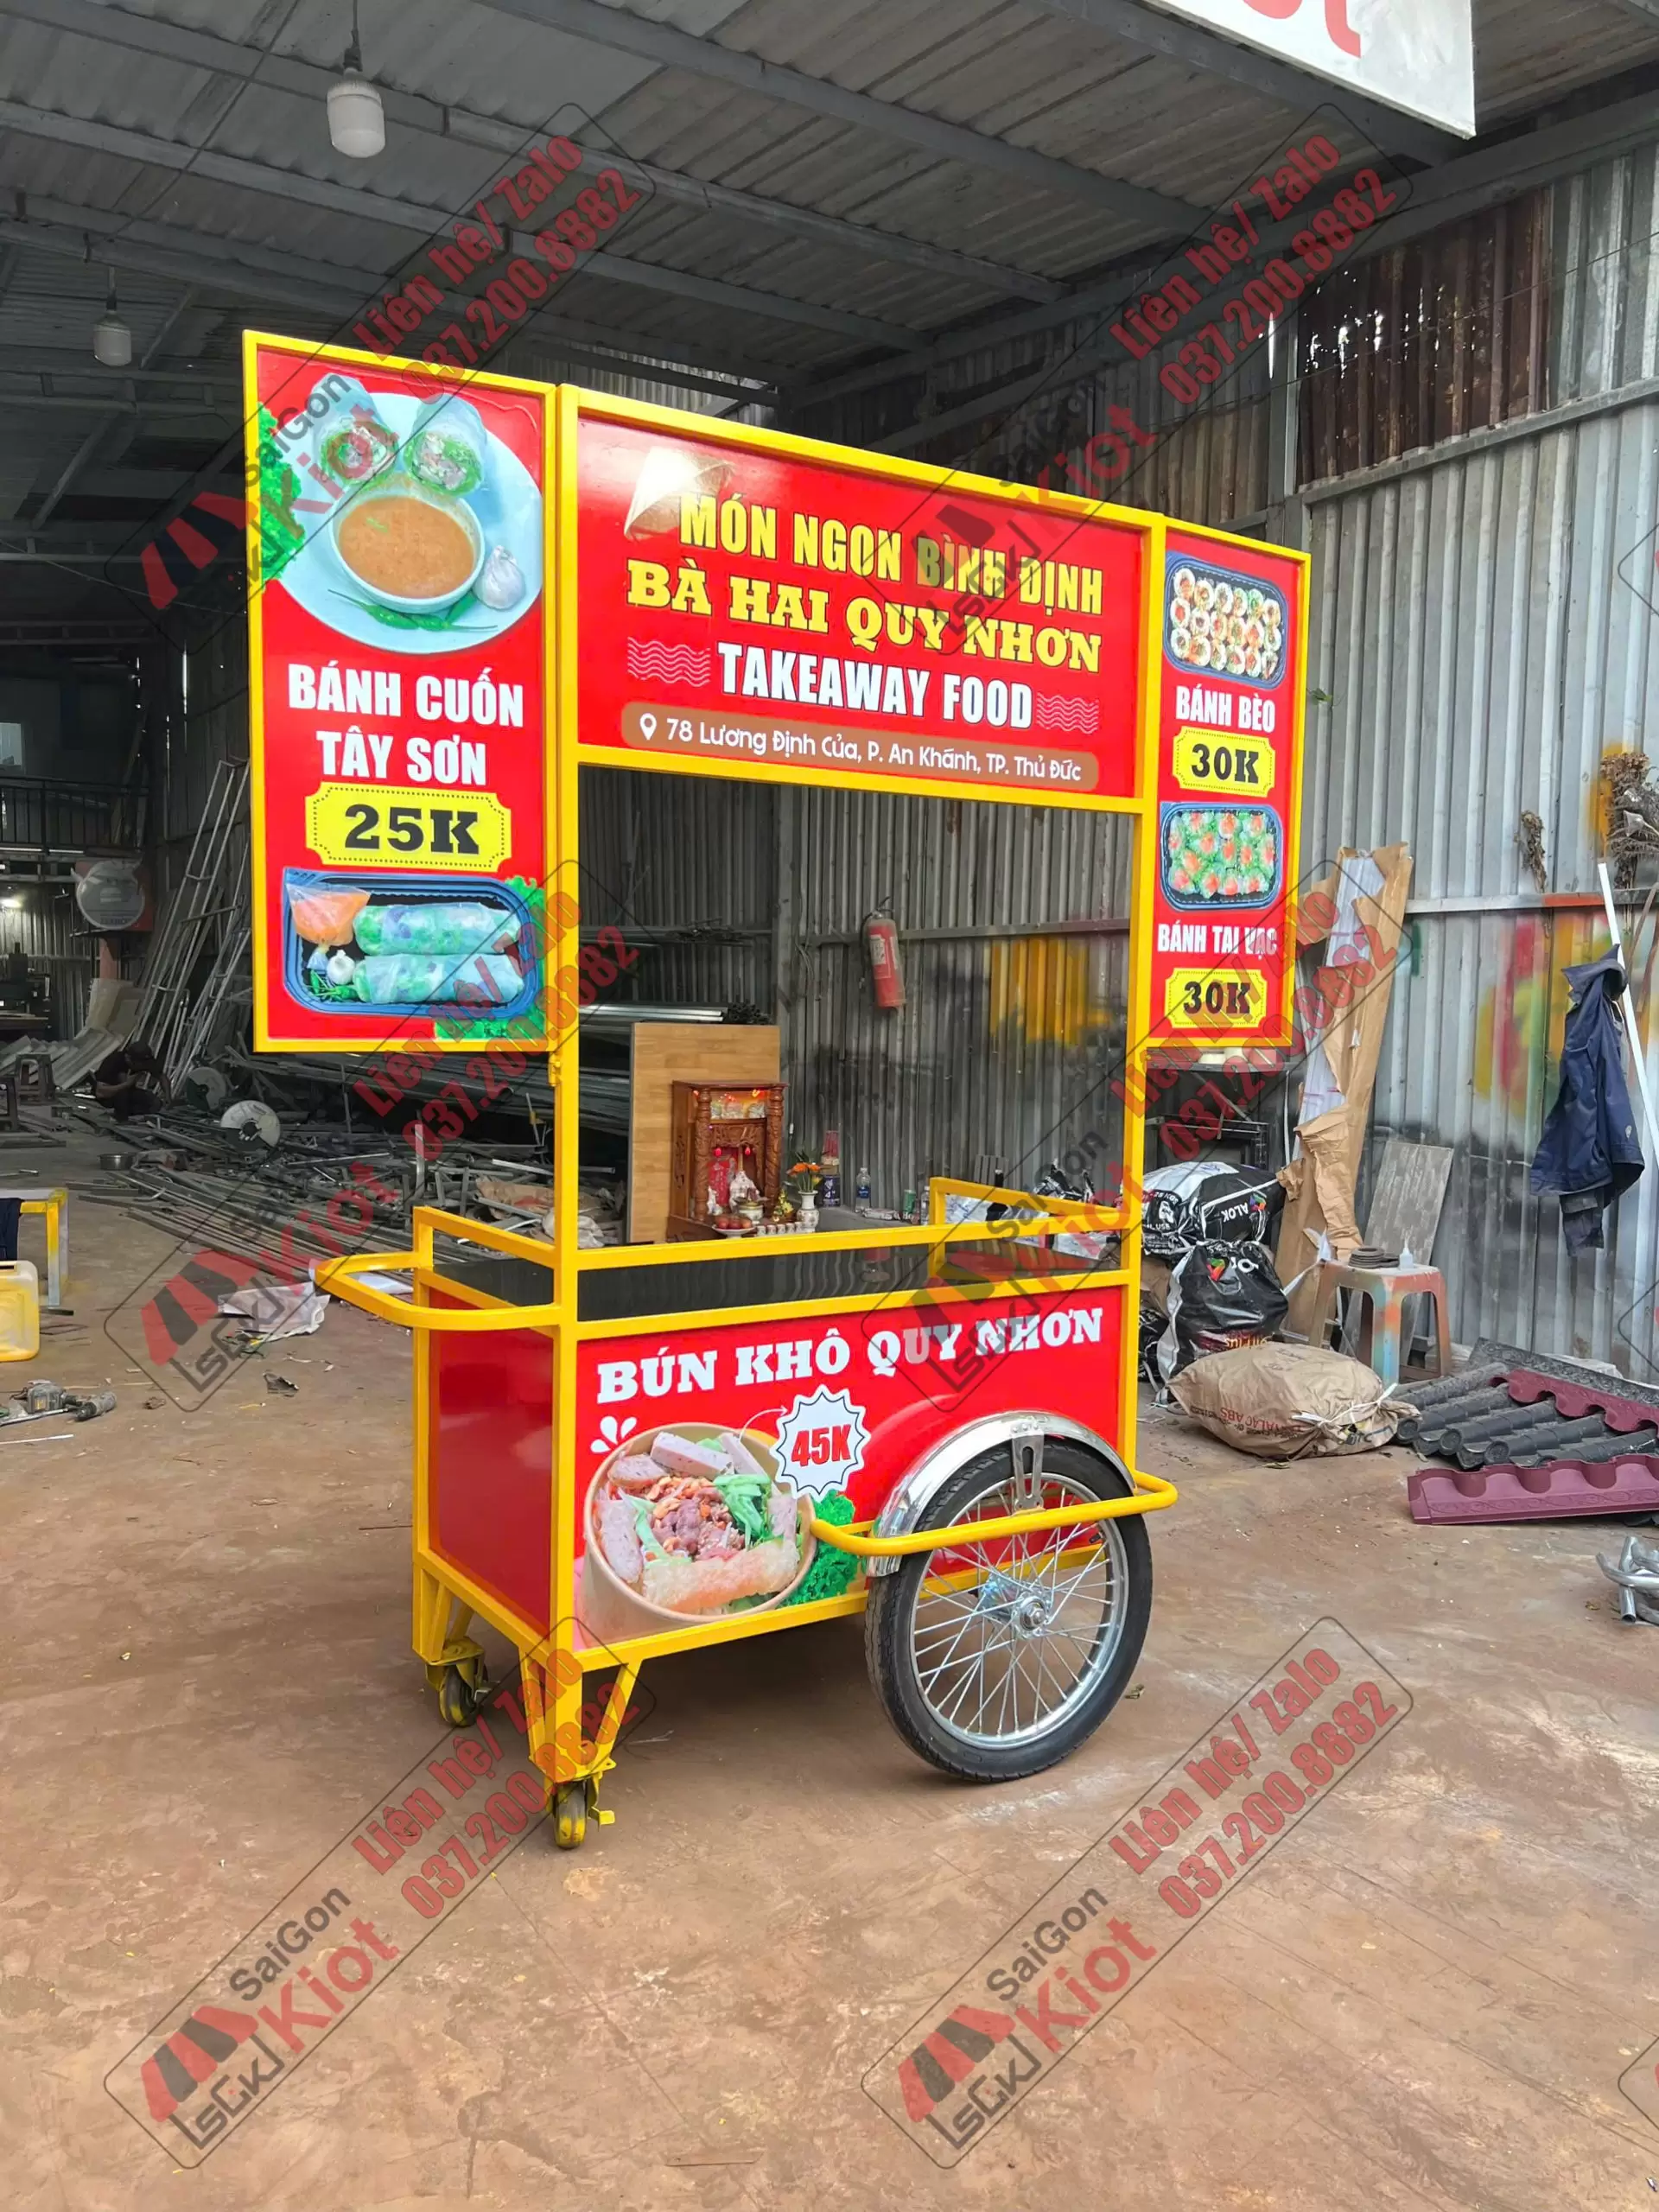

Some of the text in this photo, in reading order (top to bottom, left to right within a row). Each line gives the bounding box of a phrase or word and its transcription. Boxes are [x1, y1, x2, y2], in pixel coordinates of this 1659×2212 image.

[678, 493, 1103, 616] MÓN NGON BÌNH ĐỊNH
[626, 556, 1102, 673] BÀ HAI QUY NHƠN
[288, 659, 524, 728] BÁNH CUỐN
[716, 641, 1033, 729] TAKEAWAY FOOD
[1176, 684, 1275, 734] BÁNH BÈO
[315, 725, 486, 785] TÂY SƠN
[666, 718, 1082, 781] 78 Lương Định Của, P. An Khánh, TP. Thủ Đức
[1192, 743, 1259, 785] 30K
[344, 803, 480, 855] 25K
[1157, 919, 1277, 960] BÁNH TAI VẠC
[1184, 981, 1251, 1014] 30K
[1220, 1201, 1249, 1224] ALOK
[596, 1307, 1103, 1404] BÚN KHÔ QUY NHƠN
[791, 1426, 850, 1467] 45K
